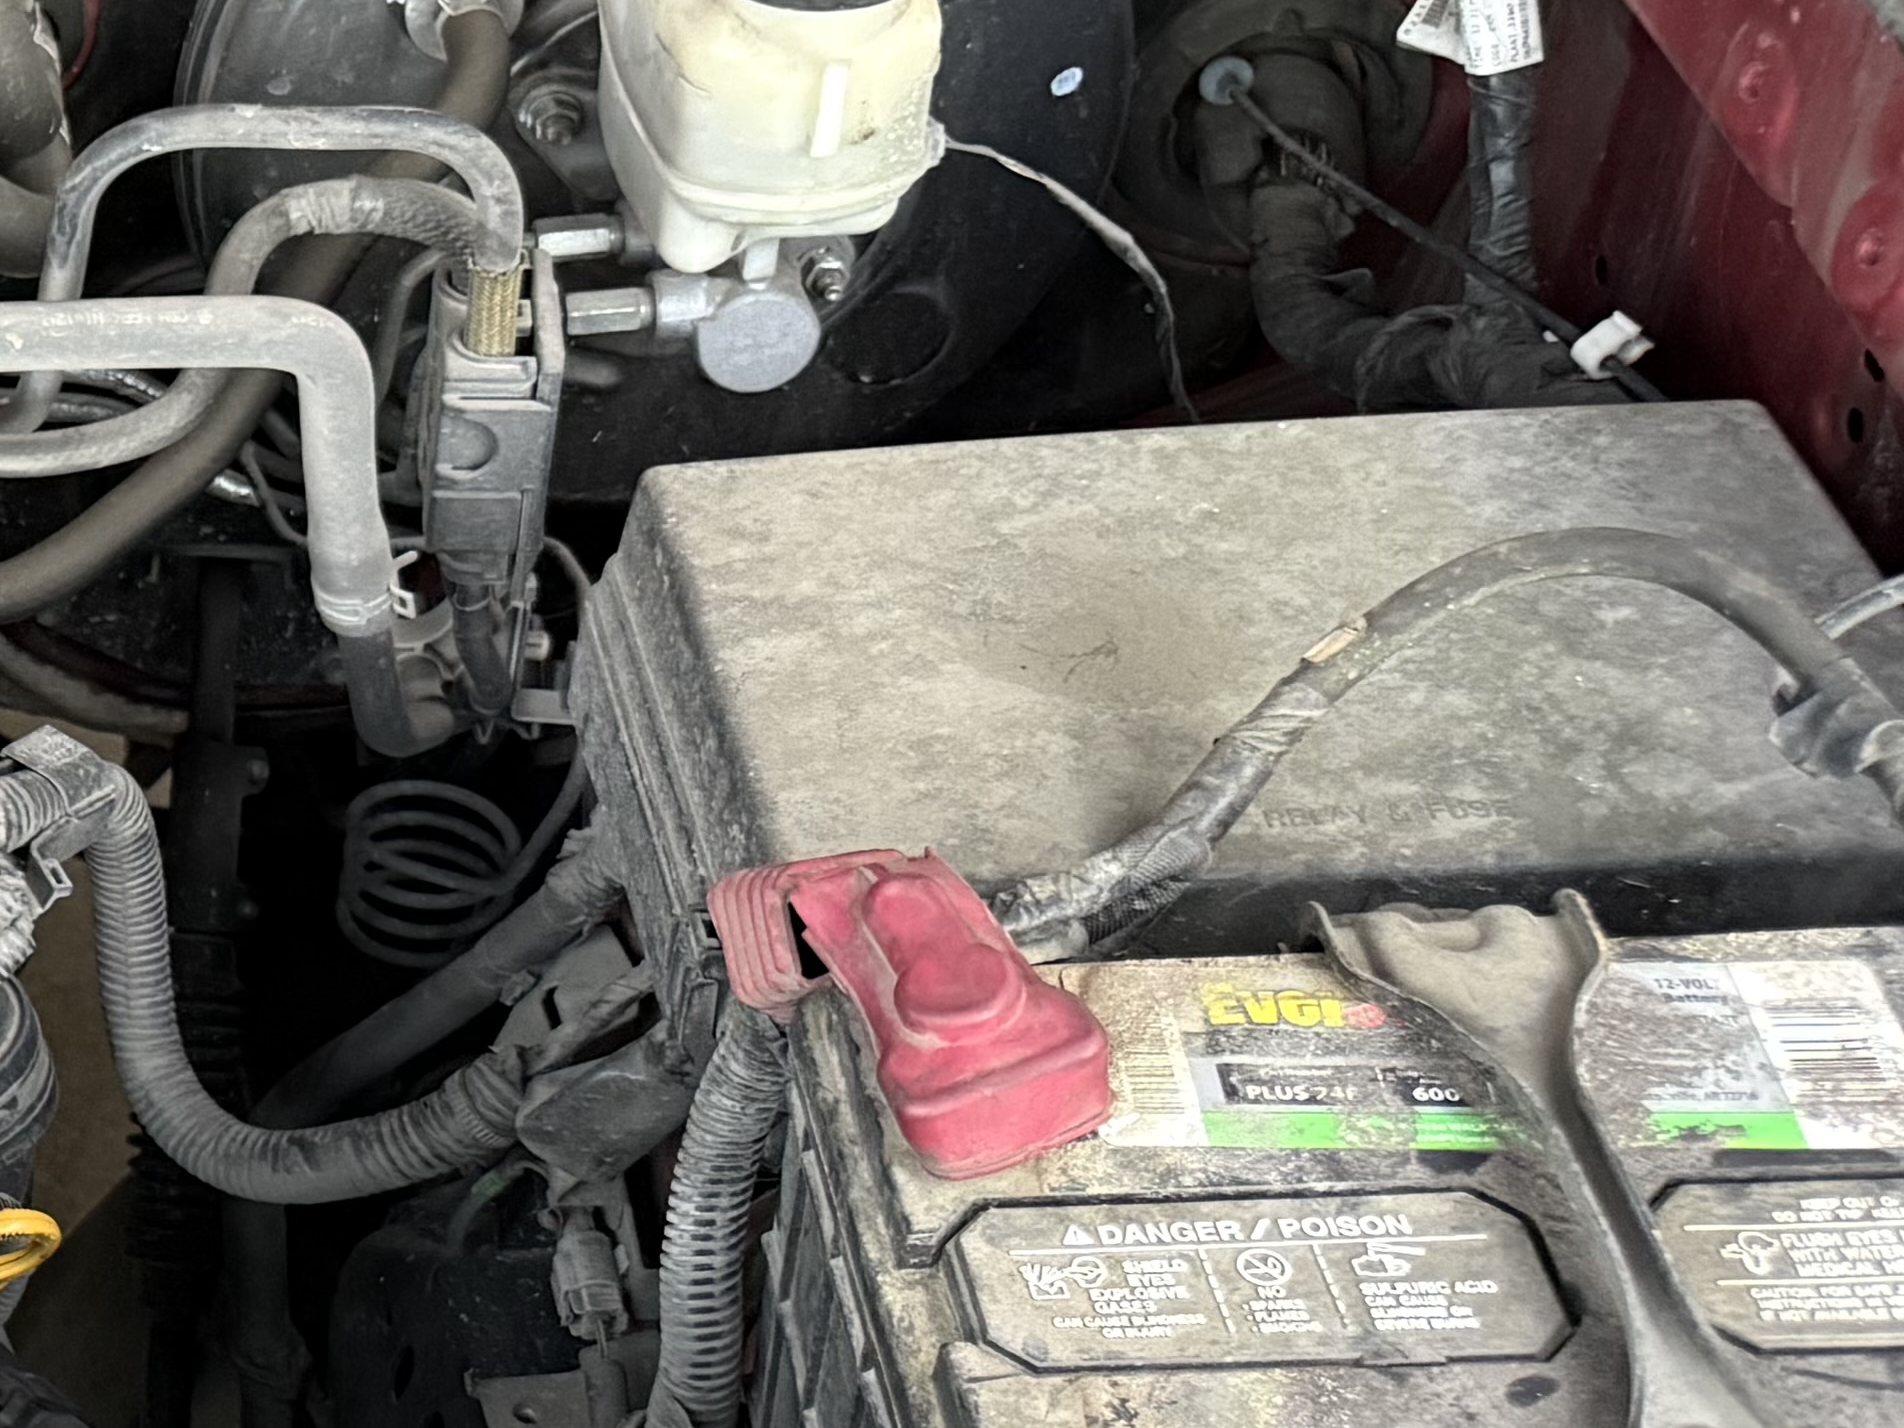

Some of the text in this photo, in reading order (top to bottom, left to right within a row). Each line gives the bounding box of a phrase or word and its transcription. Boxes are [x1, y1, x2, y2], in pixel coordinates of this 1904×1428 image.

[1261, 804, 1367, 828] RELAY
[1412, 1086, 1461, 1102] 600
[1097, 1214, 1413, 1245] DANGER / POISON
[1090, 1286, 1190, 1301] EXPLOSIVE
[1258, 1286, 1286, 1298] NO
[1359, 1280, 1499, 1296] SULFURIC ACID
[1094, 1300, 1157, 1314] GASES
